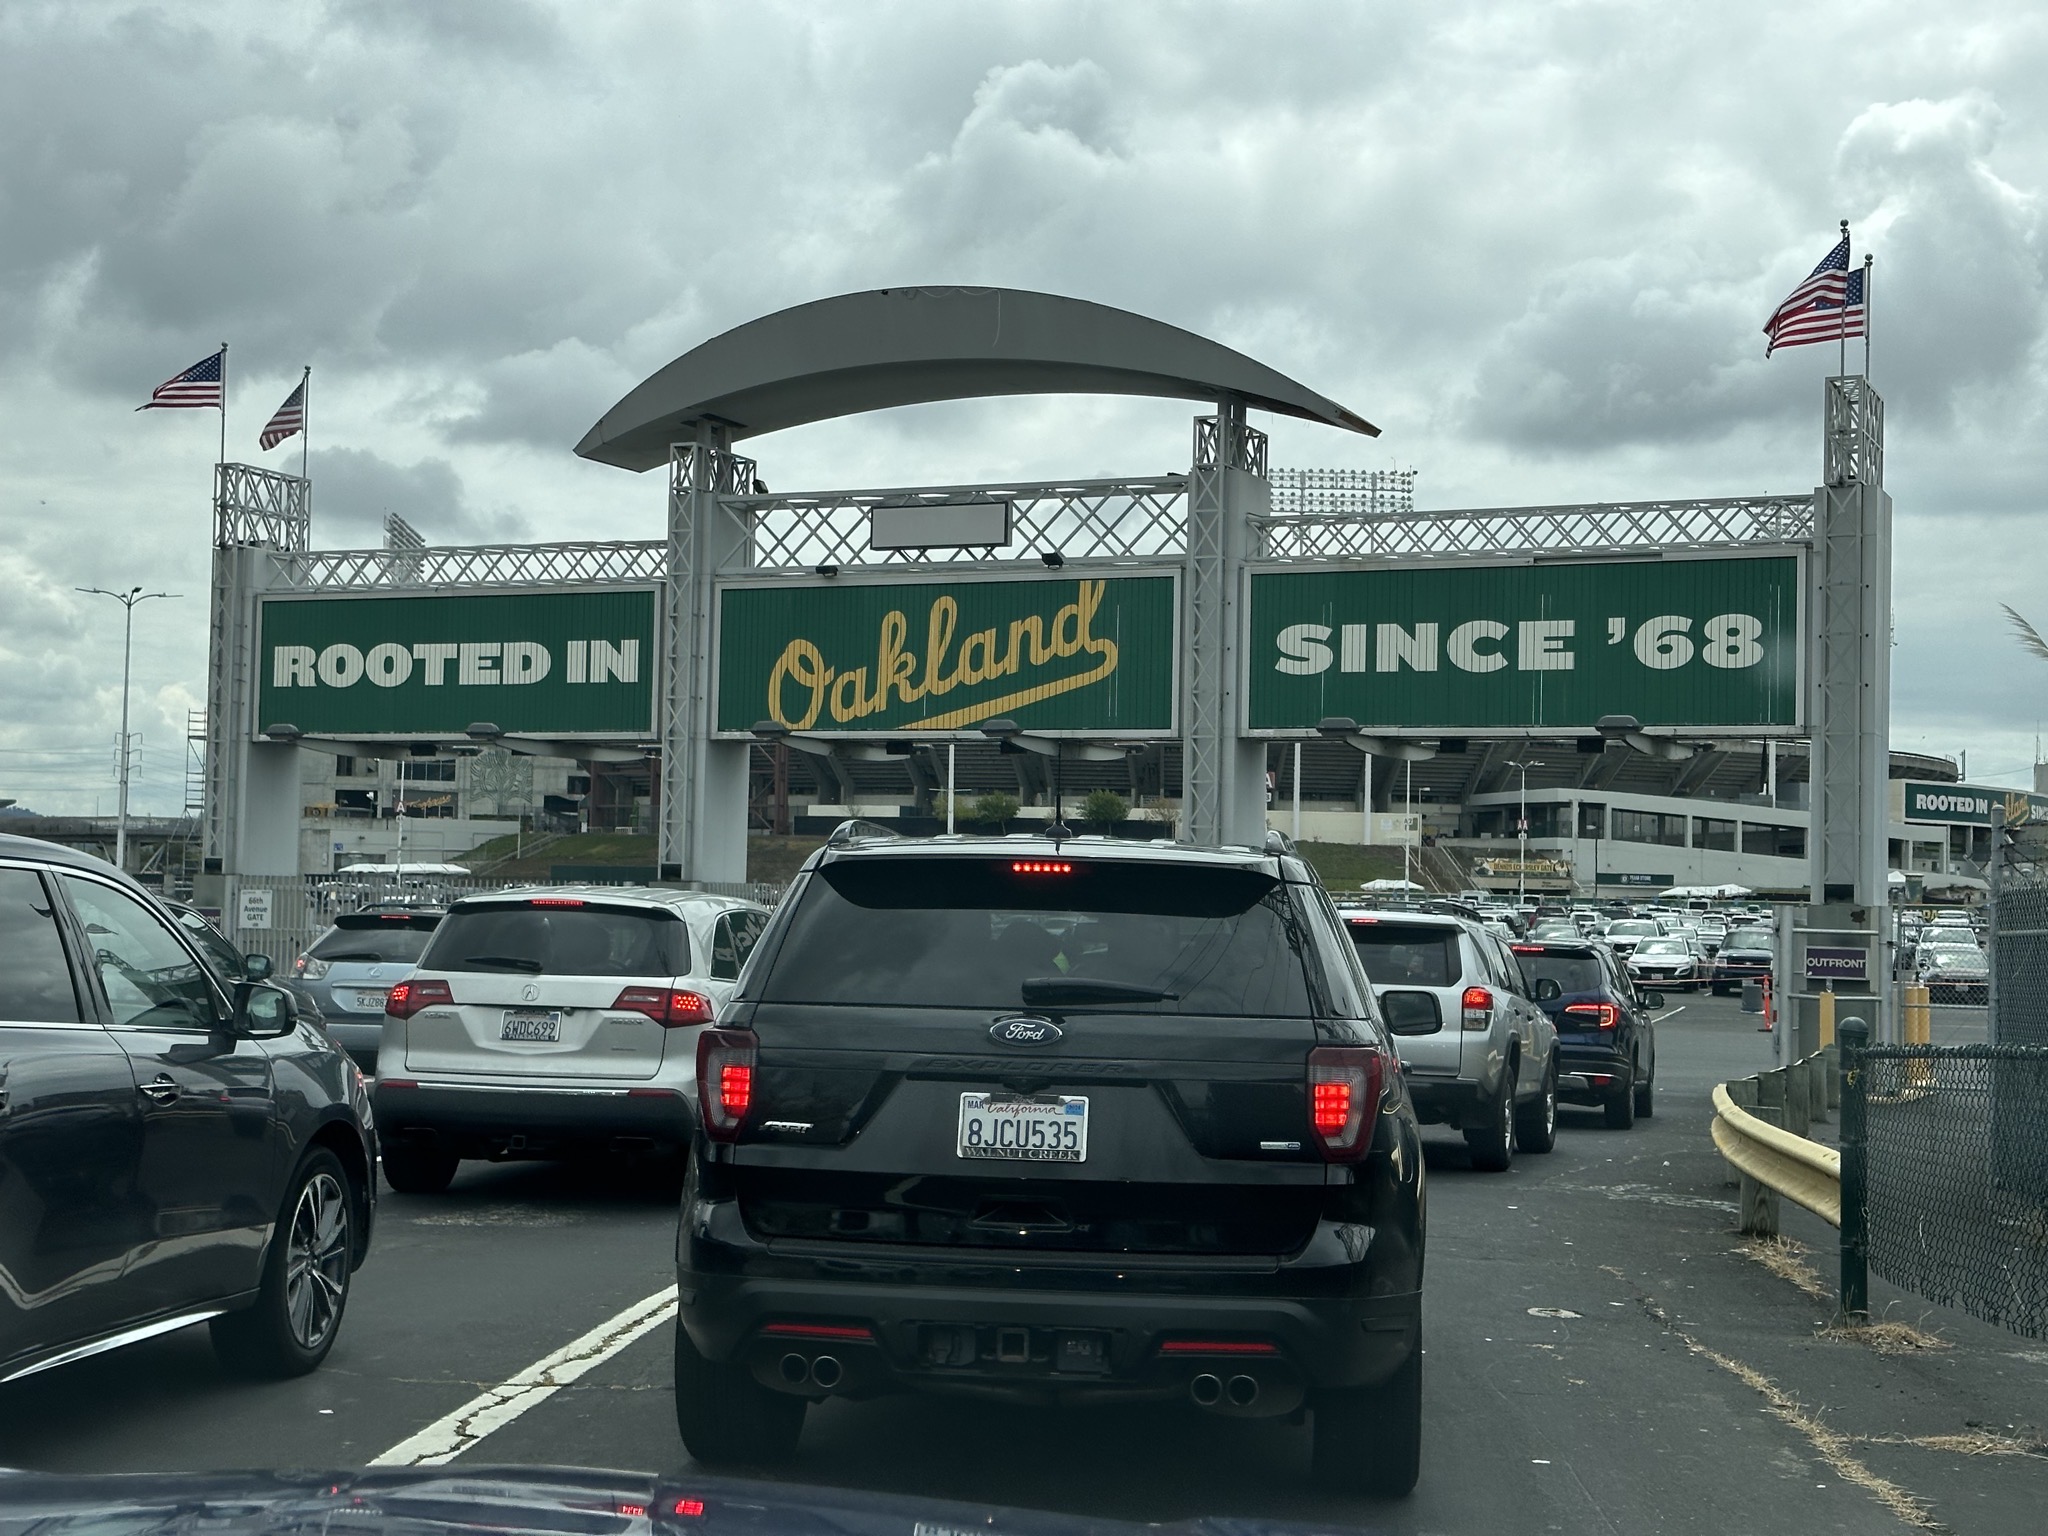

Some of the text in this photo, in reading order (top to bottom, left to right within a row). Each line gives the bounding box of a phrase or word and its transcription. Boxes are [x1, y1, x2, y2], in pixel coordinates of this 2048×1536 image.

[1274, 613, 1765, 676] SINCE '68
[273, 638, 639, 688] ROOTED IN
[768, 580, 1118, 730] Oakland
[1916, 793, 1988, 815] ROOTED IN
[243, 905, 268, 913] Avenue
[248, 896, 264, 905] 66th
[247, 913, 264, 921] GATE
[1806, 957, 1866, 969] OUTFRONT
[504, 1020, 556, 1037] 6WDC699
[1004, 1023, 1046, 1041] Ford
[924, 1058, 1126, 1074] EXPLORER
[967, 1100, 985, 1110] MAR
[987, 1103, 1064, 1118] California
[967, 1118, 1078, 1150] 8JCU535
[965, 1147, 1078, 1160] WALNUT CREEK
